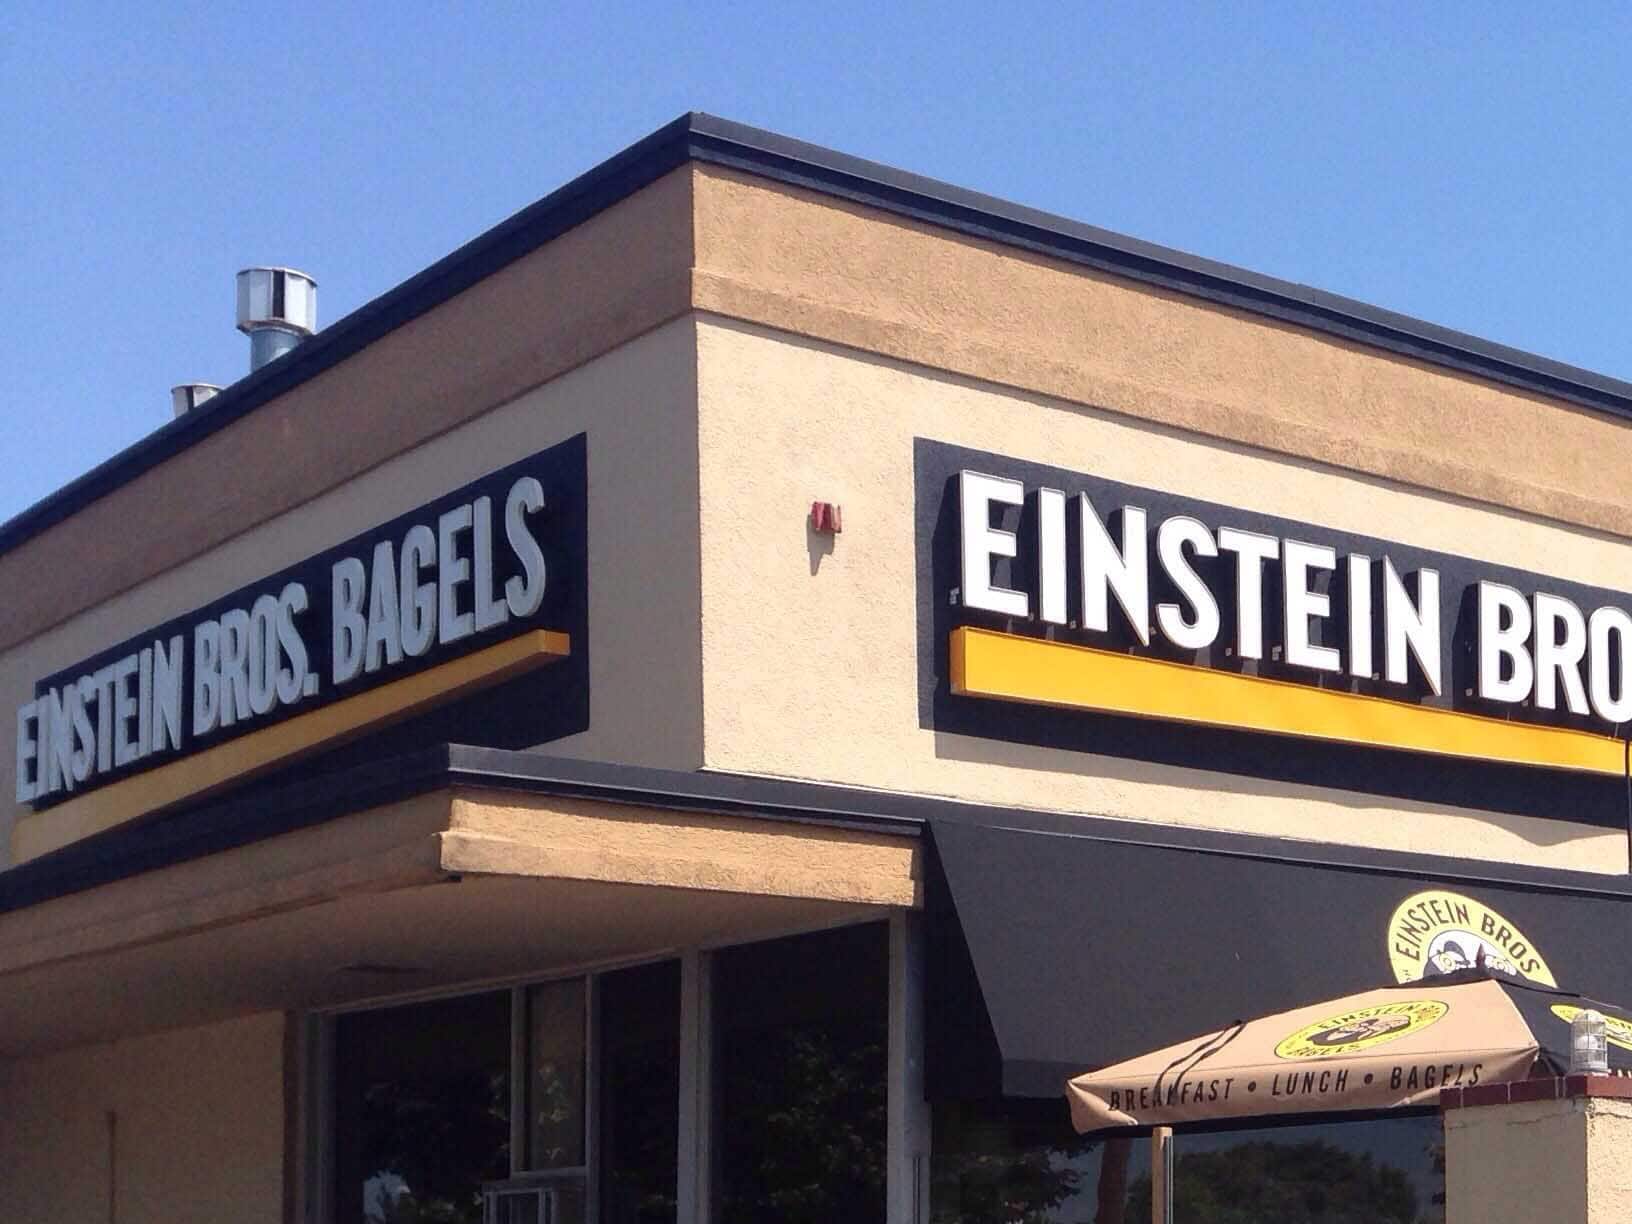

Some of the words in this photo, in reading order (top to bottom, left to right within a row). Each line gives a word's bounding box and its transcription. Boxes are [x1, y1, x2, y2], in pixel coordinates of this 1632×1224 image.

[16, 634, 184, 806] EINSTEIN
[193, 581, 319, 736] BROS.
[331, 475, 547, 685] BAGELS
[960, 469, 1442, 698] EINSTEIN
[1396, 899, 1471, 961] EINSTEIN
[1481, 912, 1541, 974] BROS
[1108, 1078, 1235, 1113] BREAKFAST
[1271, 1069, 1348, 1097] LUNCH
[1389, 1063, 1484, 1091] BAGELS
